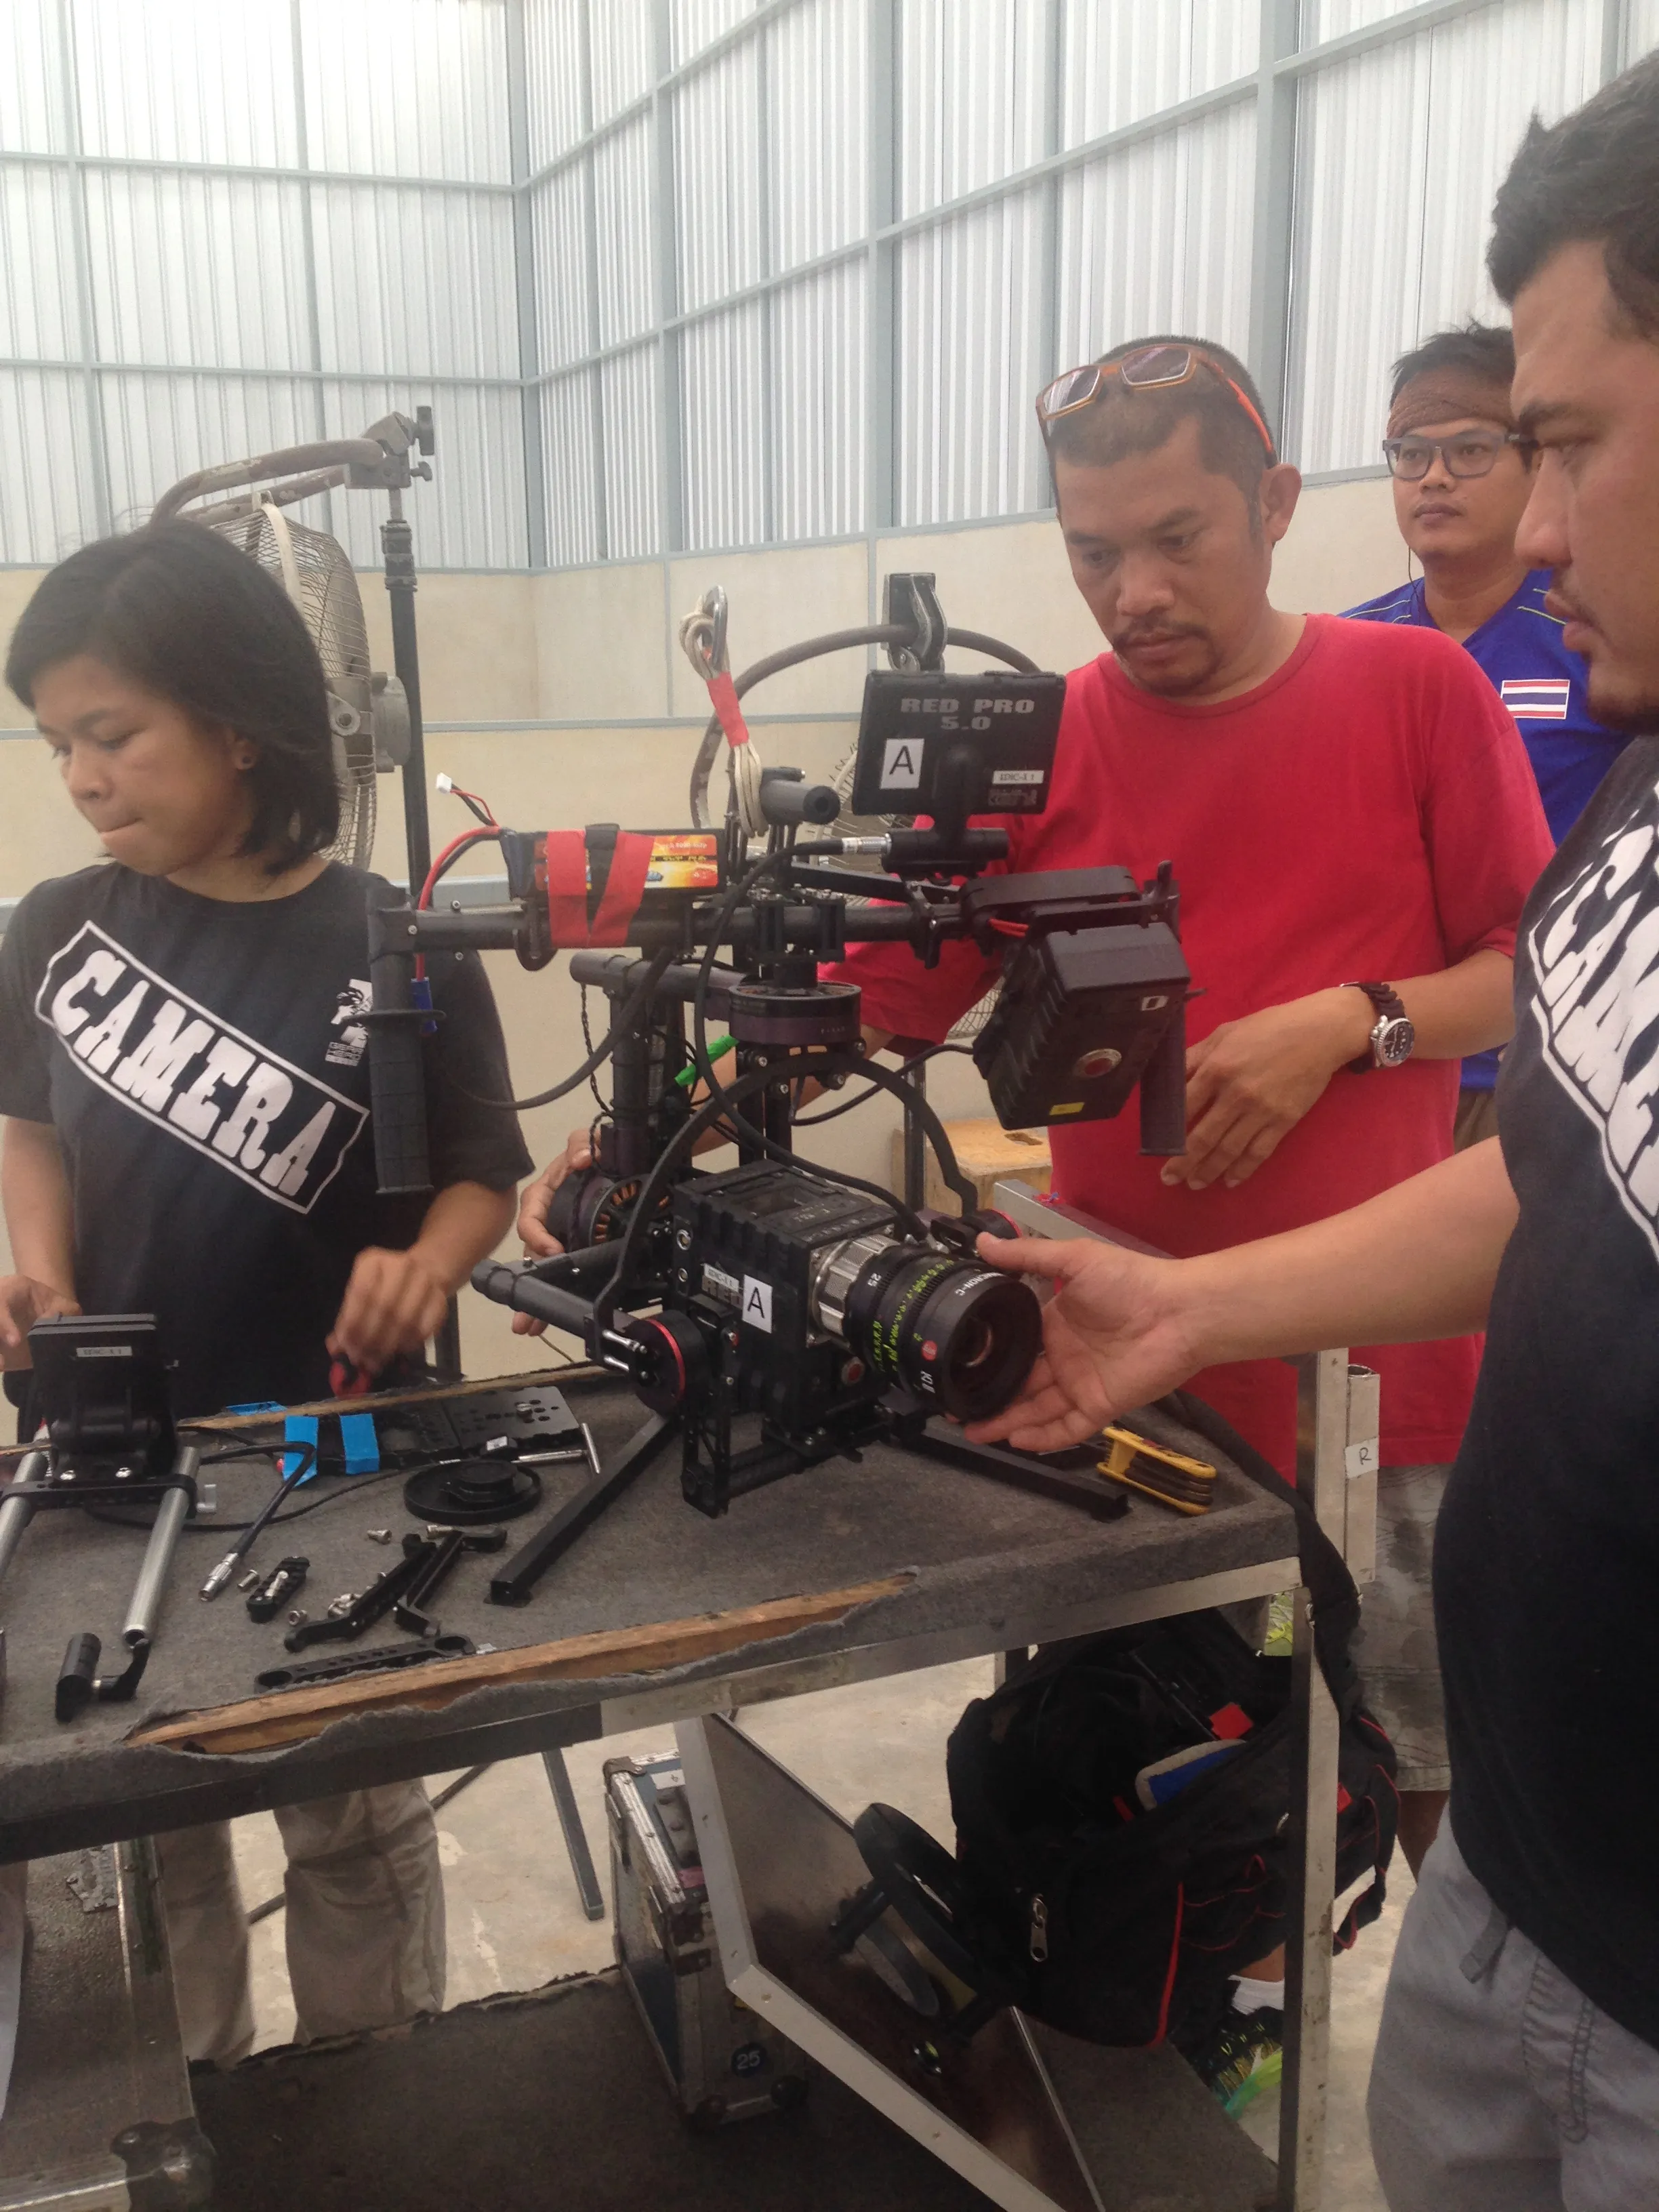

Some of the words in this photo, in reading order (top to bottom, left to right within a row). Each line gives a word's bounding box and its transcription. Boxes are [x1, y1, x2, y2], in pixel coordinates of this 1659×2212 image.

[901, 698, 960, 713] RED
[974, 699, 1035, 714] PRO
[941, 716, 991, 731] 5.0
[889, 745, 914, 775] A
[51, 949, 337, 1197] CAMERA
[747, 1286, 765, 1319] A
[737, 2050, 760, 2070] 25
